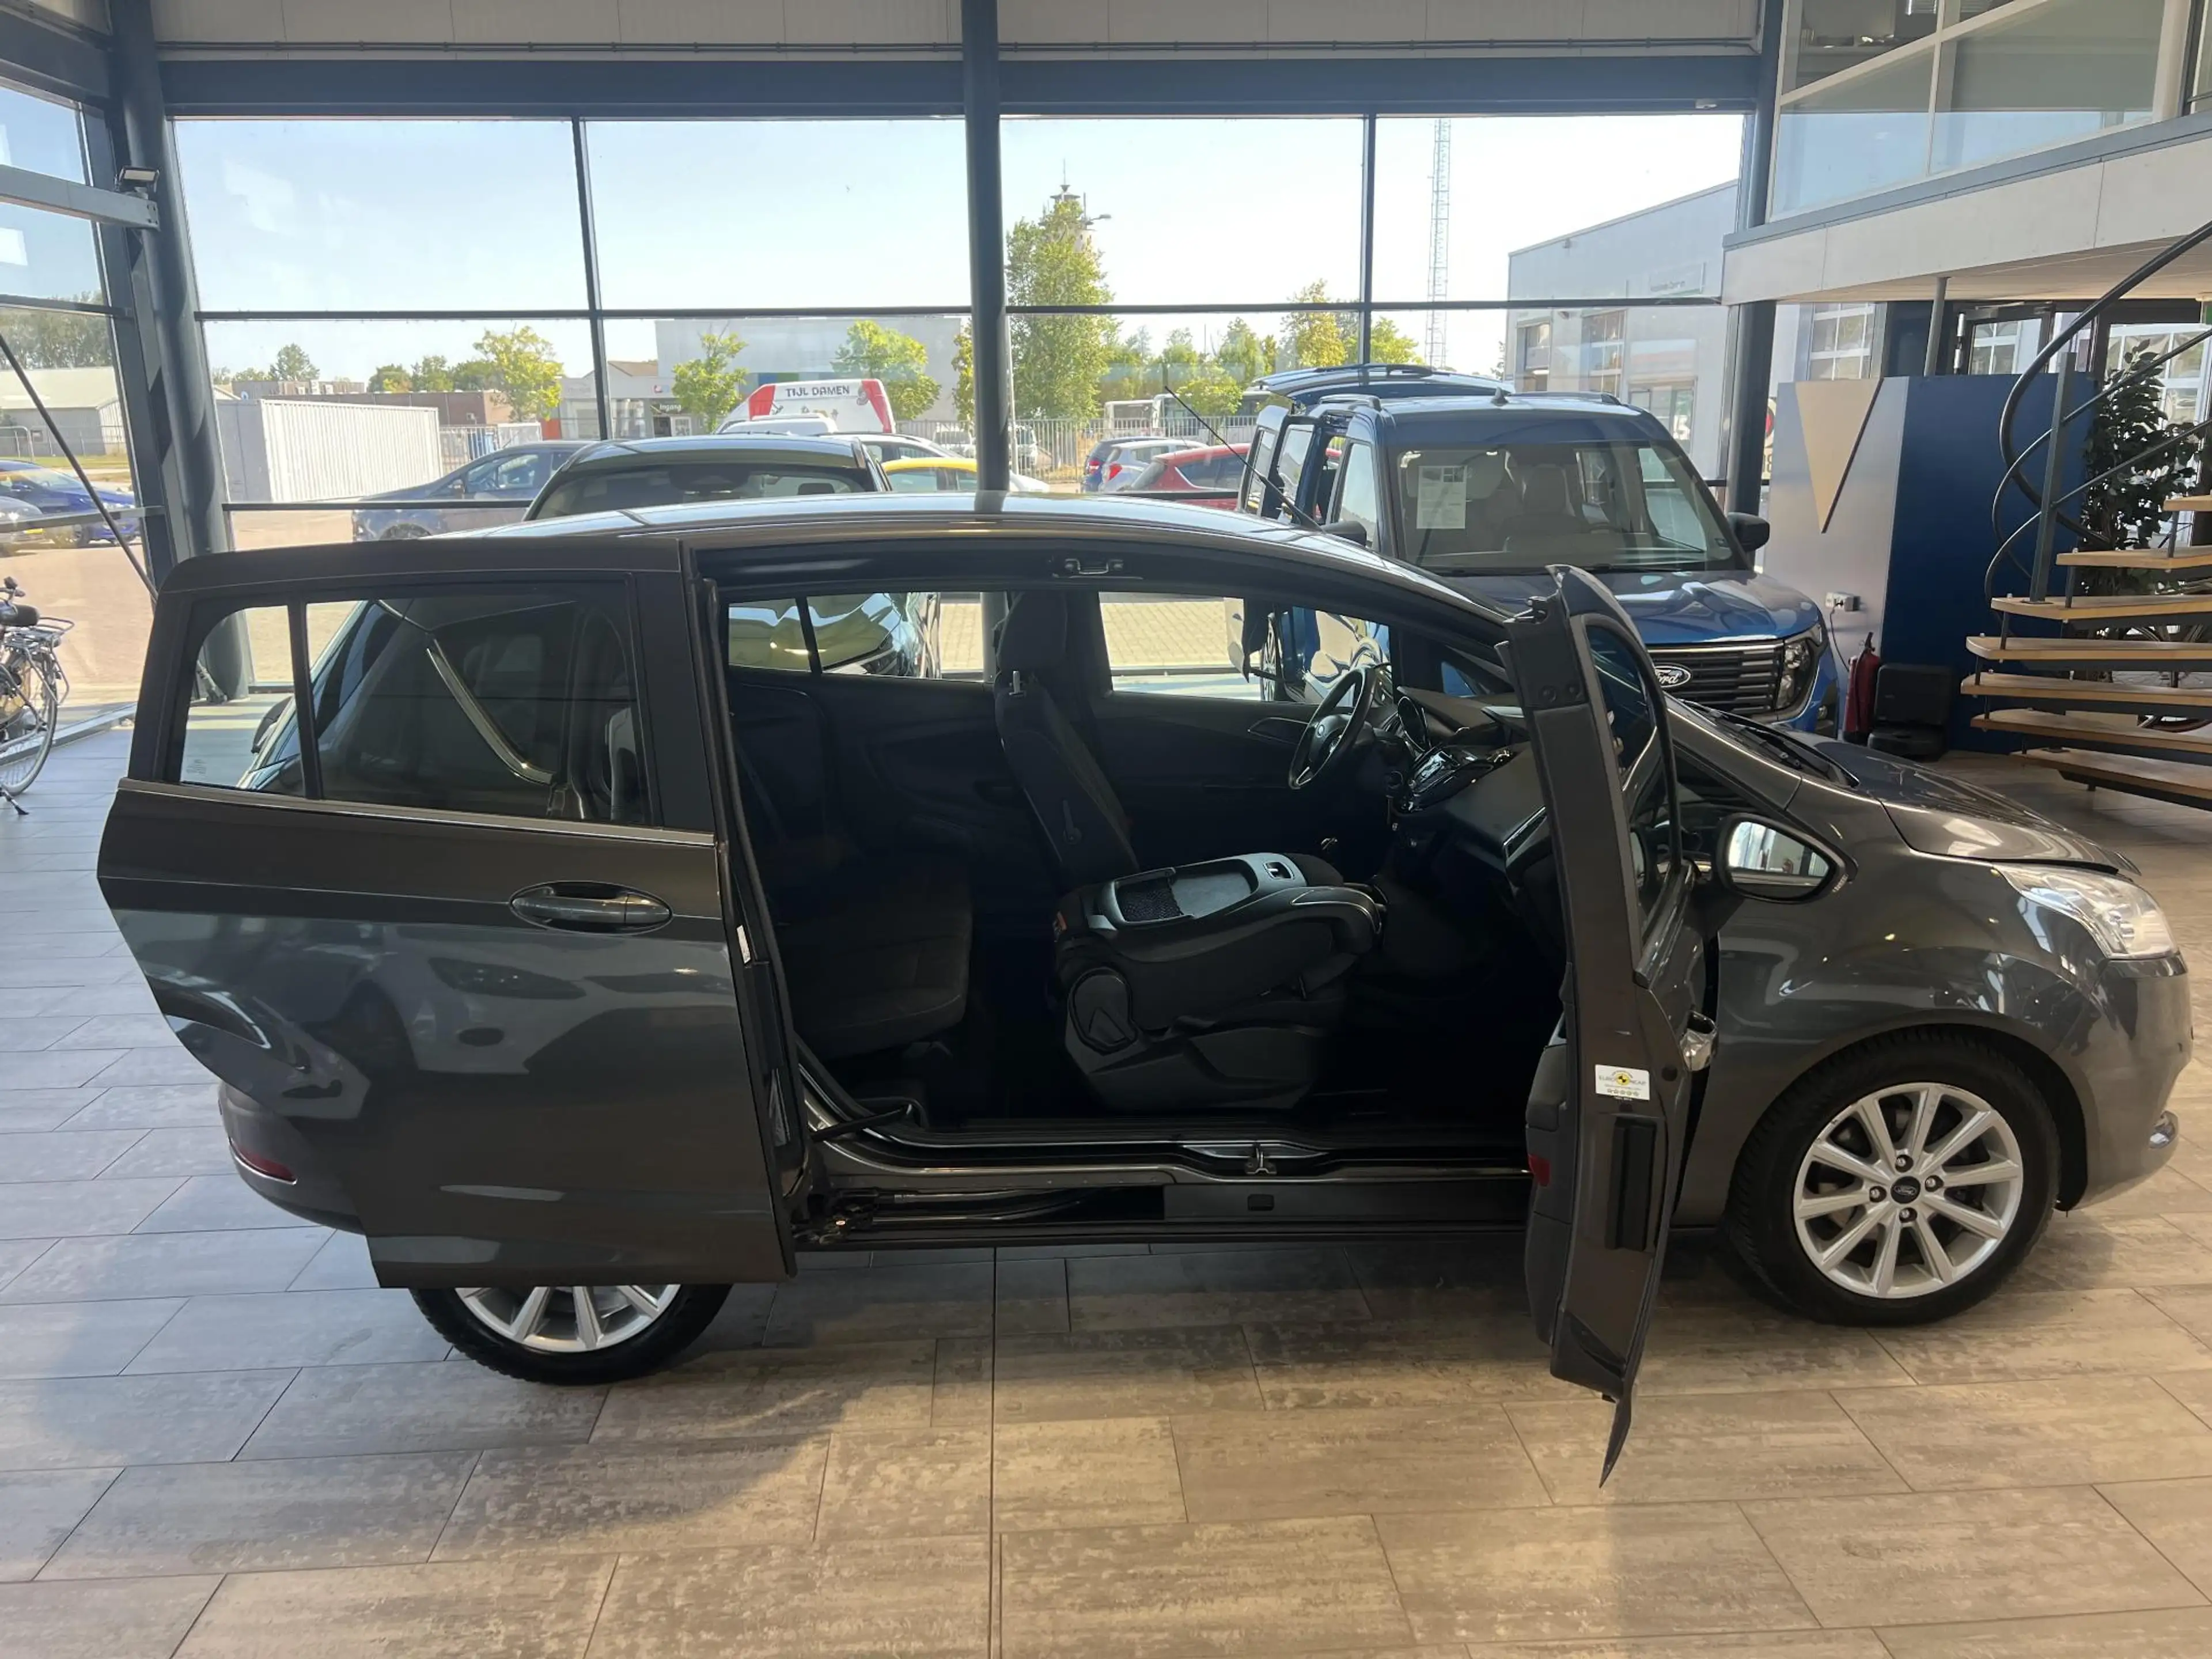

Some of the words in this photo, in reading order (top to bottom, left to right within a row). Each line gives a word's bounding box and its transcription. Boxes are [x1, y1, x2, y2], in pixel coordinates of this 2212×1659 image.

[785, 387, 809, 397] TIJL
[812, 385, 850, 396] DAMEN
[659, 404, 681, 413] Ingang
